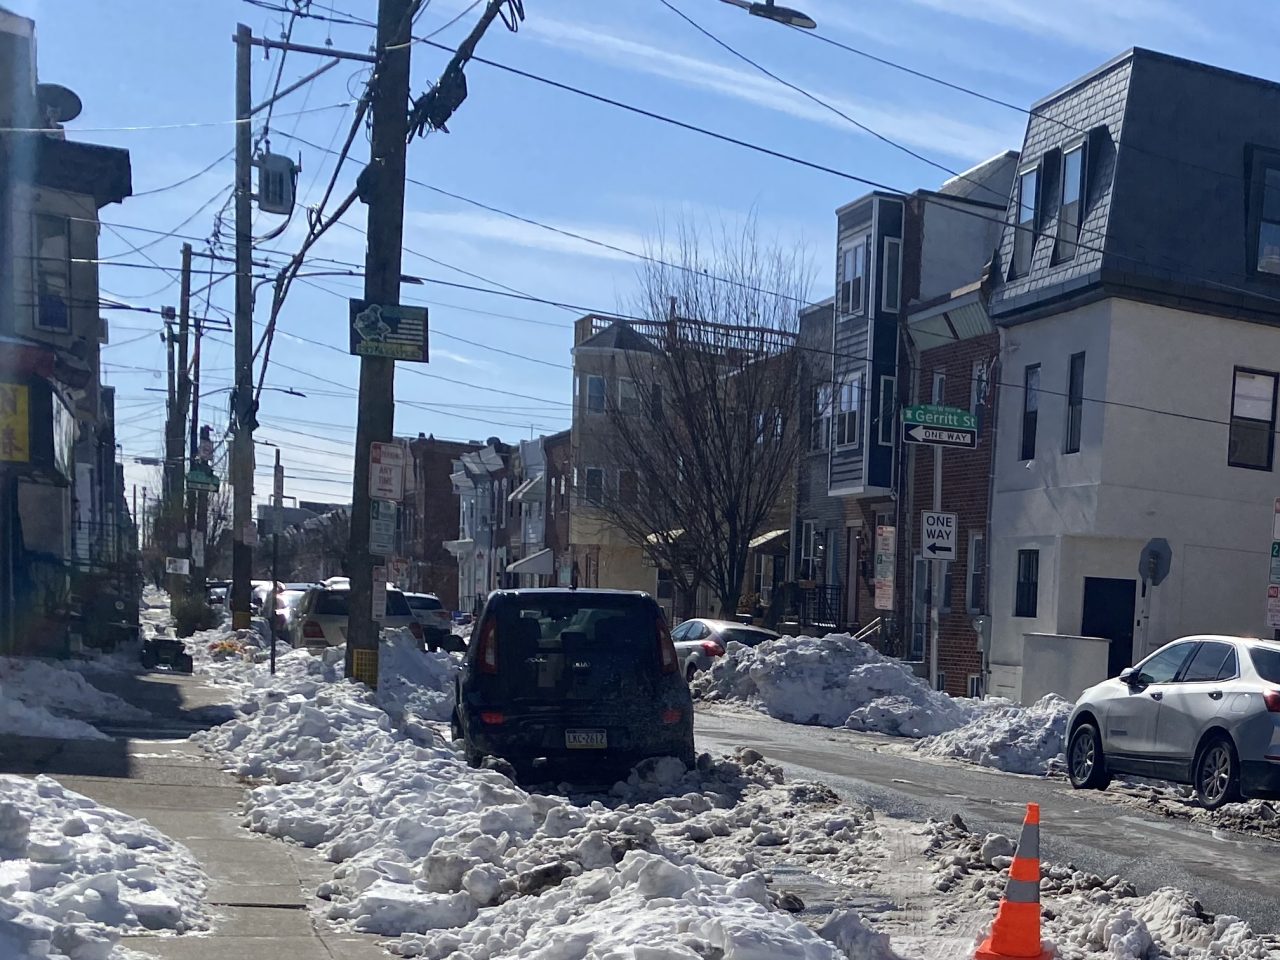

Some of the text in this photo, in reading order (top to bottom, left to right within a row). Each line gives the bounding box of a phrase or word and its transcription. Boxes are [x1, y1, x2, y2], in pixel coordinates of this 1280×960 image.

[915, 410, 975, 427] Gerritt St
[924, 430, 967, 441] ONE WAY
[379, 466, 391, 474] ANY
[379, 476, 392, 485] TIME
[926, 515, 953, 527] ONE
[926, 528, 952, 540] WAY
[1272, 544, 1279, 556] 2
